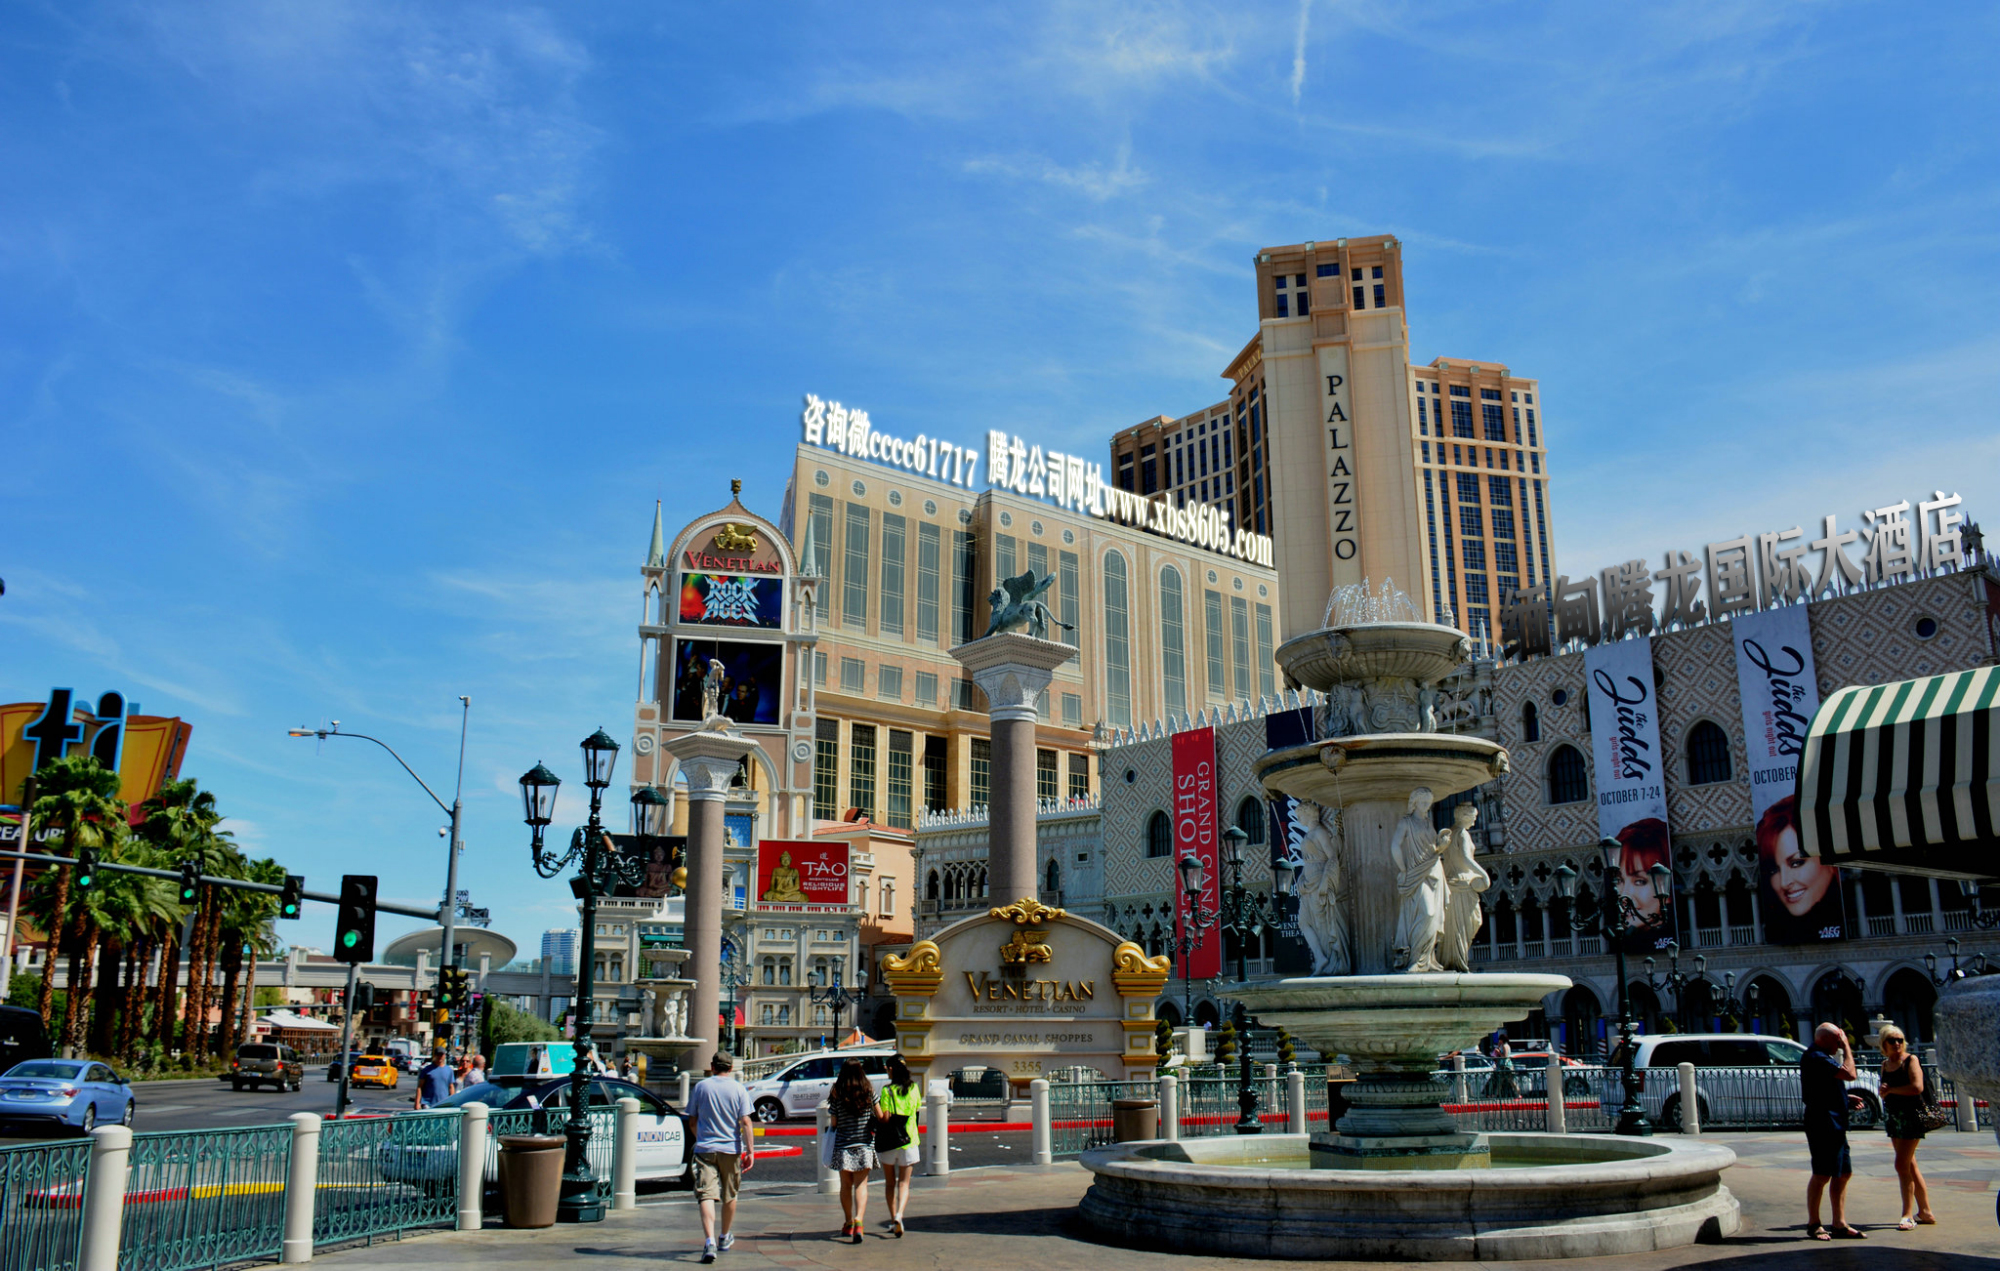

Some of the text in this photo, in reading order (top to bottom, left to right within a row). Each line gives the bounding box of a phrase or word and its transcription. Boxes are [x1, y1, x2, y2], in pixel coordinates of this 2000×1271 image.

[1326, 375, 1357, 560] PALAZZO
[685, 551, 780, 571] VENETIAN
[702, 576, 760, 605] ROCK
[701, 598, 760, 625] AGES
[1743, 639, 1808, 756] Judds
[1792, 685, 1806, 704] the
[1594, 669, 1651, 780] Judds
[1635, 712, 1648, 731] the
[1753, 766, 1797, 785] OCTOBER
[1197, 761, 1212, 844] GRAND
[1600, 786, 1660, 806] OCTOBER 7-24
[801, 861, 847, 876] TAO
[998, 965, 1027, 978] THE
[962, 971, 1095, 1002] VENETIAN
[973, 1005, 1086, 1014] RESORT HOTEL CASINO
[960, 1033, 1093, 1043] GRAND CANAL SHOPPES
[1013, 1061, 1042, 1073] 3355
[665, 1131, 681, 1141] CAB
